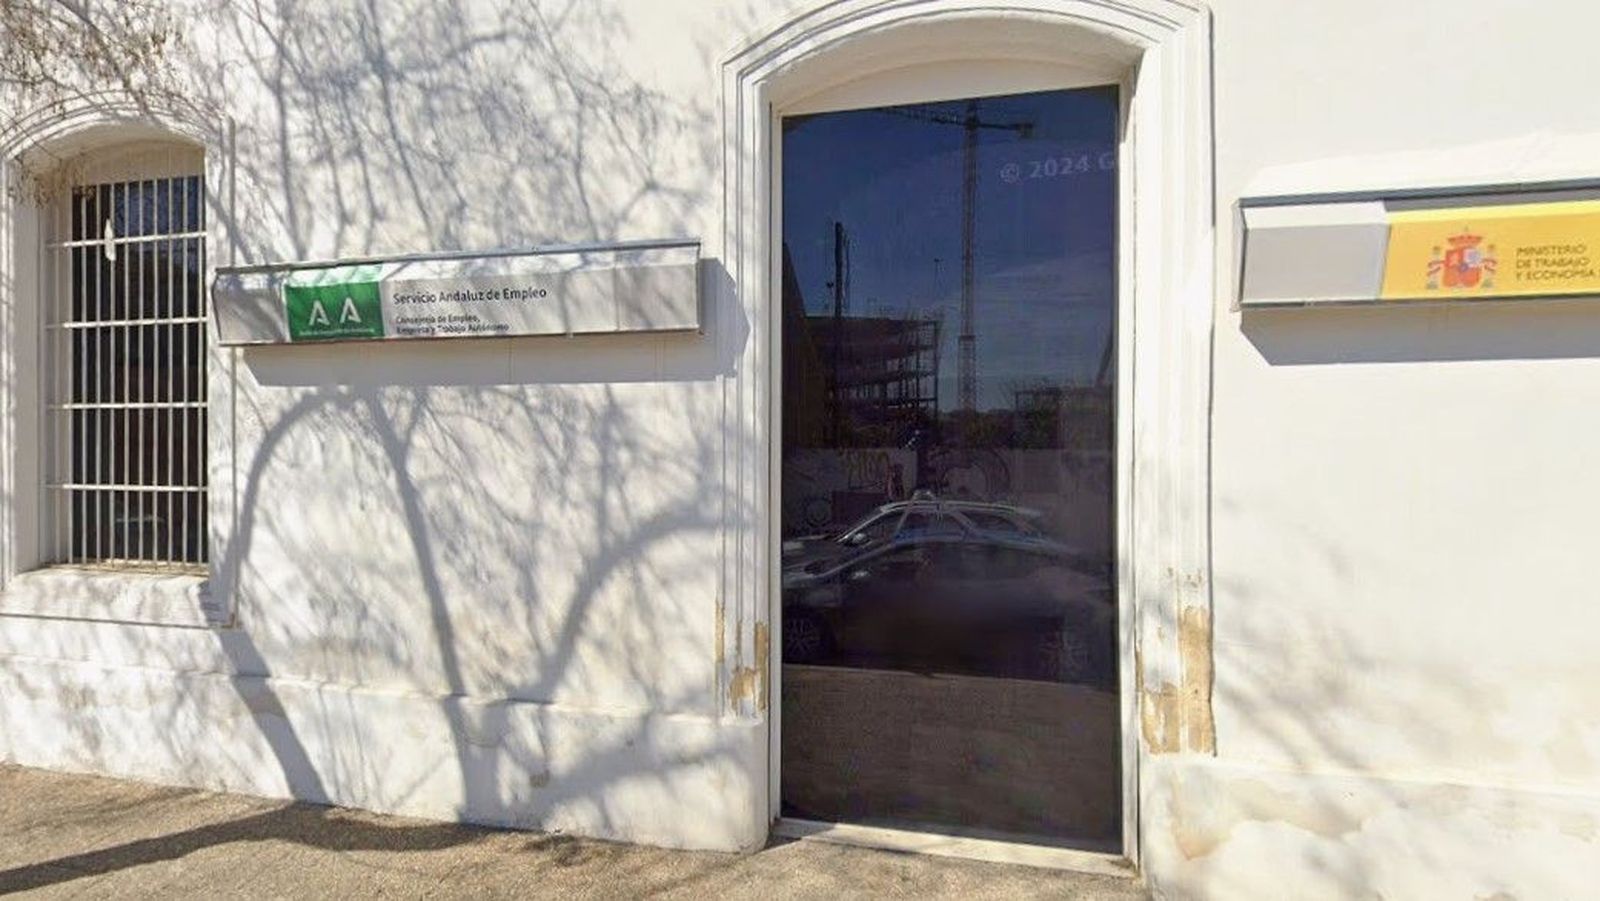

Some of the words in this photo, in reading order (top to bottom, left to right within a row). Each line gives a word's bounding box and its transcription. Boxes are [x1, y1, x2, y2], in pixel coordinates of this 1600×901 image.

[1516, 244, 1587, 256] MINISTERIO
[1516, 258, 1531, 269] DE
[1535, 256, 1591, 268] TRABAJO
[1516, 271, 1522, 281] Y
[392, 291, 437, 305] Servicio
[440, 289, 484, 303] Andaluz
[486, 288, 501, 300] de
[503, 286, 548, 302] Empleo
